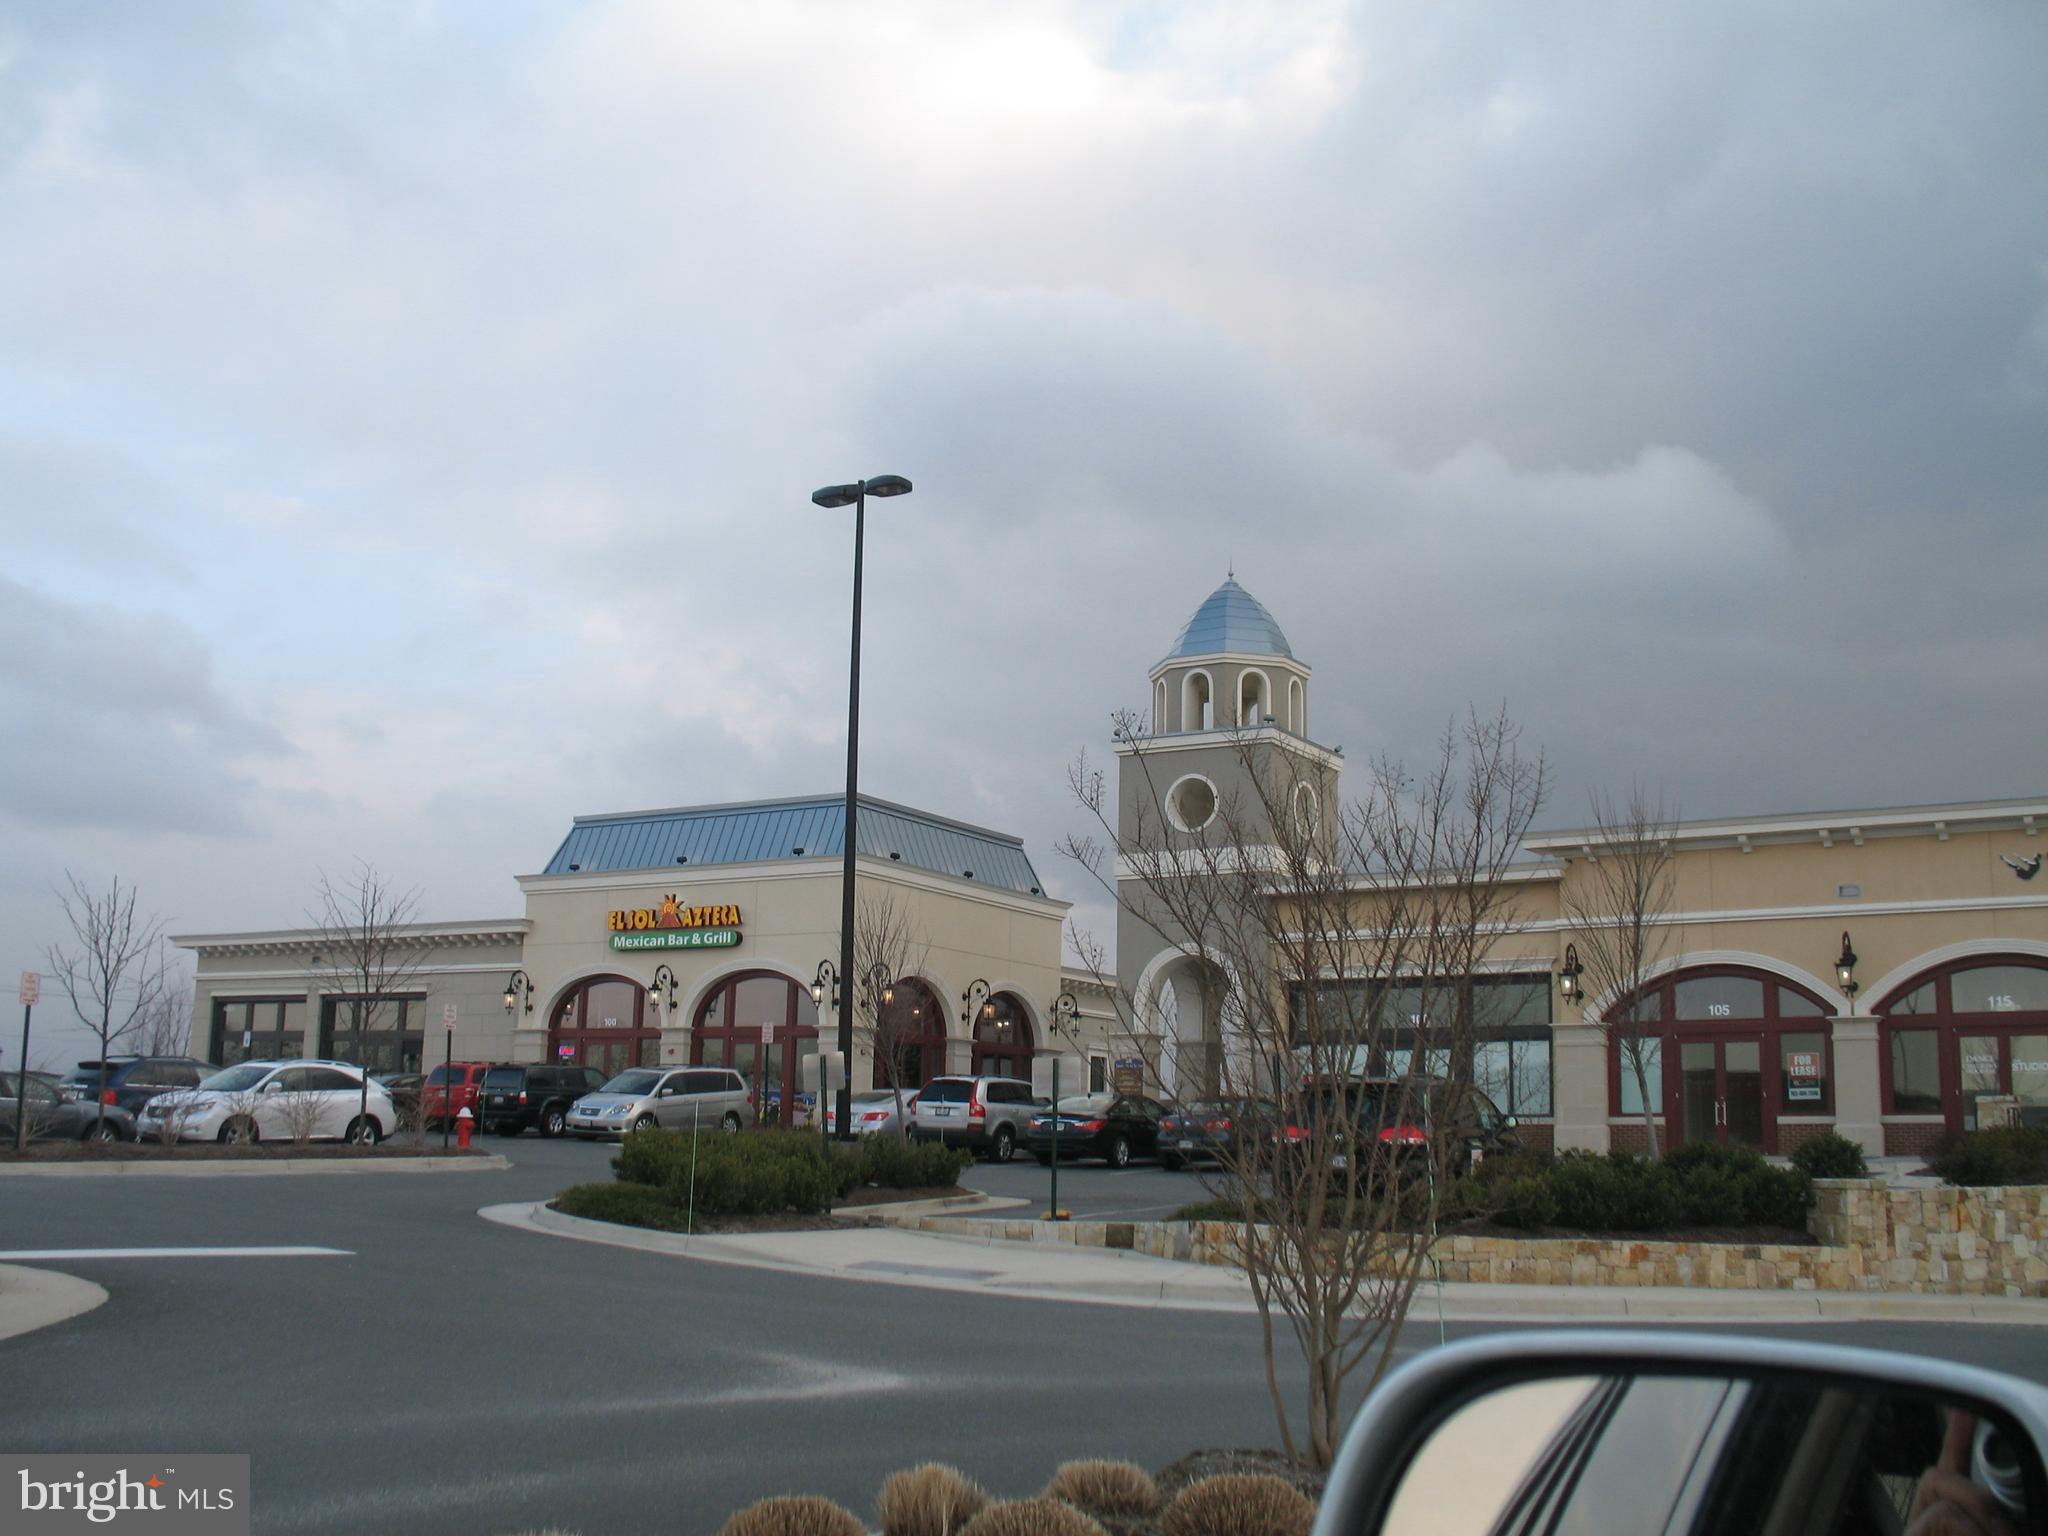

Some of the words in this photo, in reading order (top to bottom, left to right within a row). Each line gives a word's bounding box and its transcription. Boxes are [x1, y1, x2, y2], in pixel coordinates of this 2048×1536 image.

[608, 911, 625, 930] EL
[627, 909, 657, 930] SOL
[682, 905, 742, 927] AZTECA
[614, 935, 665, 948] Mexican
[668, 934, 689, 945] Bar
[691, 932, 701, 944] &
[703, 931, 731, 944] Grill
[1987, 995, 2013, 1008] 115
[1708, 1004, 1730, 1016] 105
[604, 1017, 617, 1027] 100
[1792, 1055, 1812, 1065] FOR
[1790, 1065, 1817, 1076] LEASE
